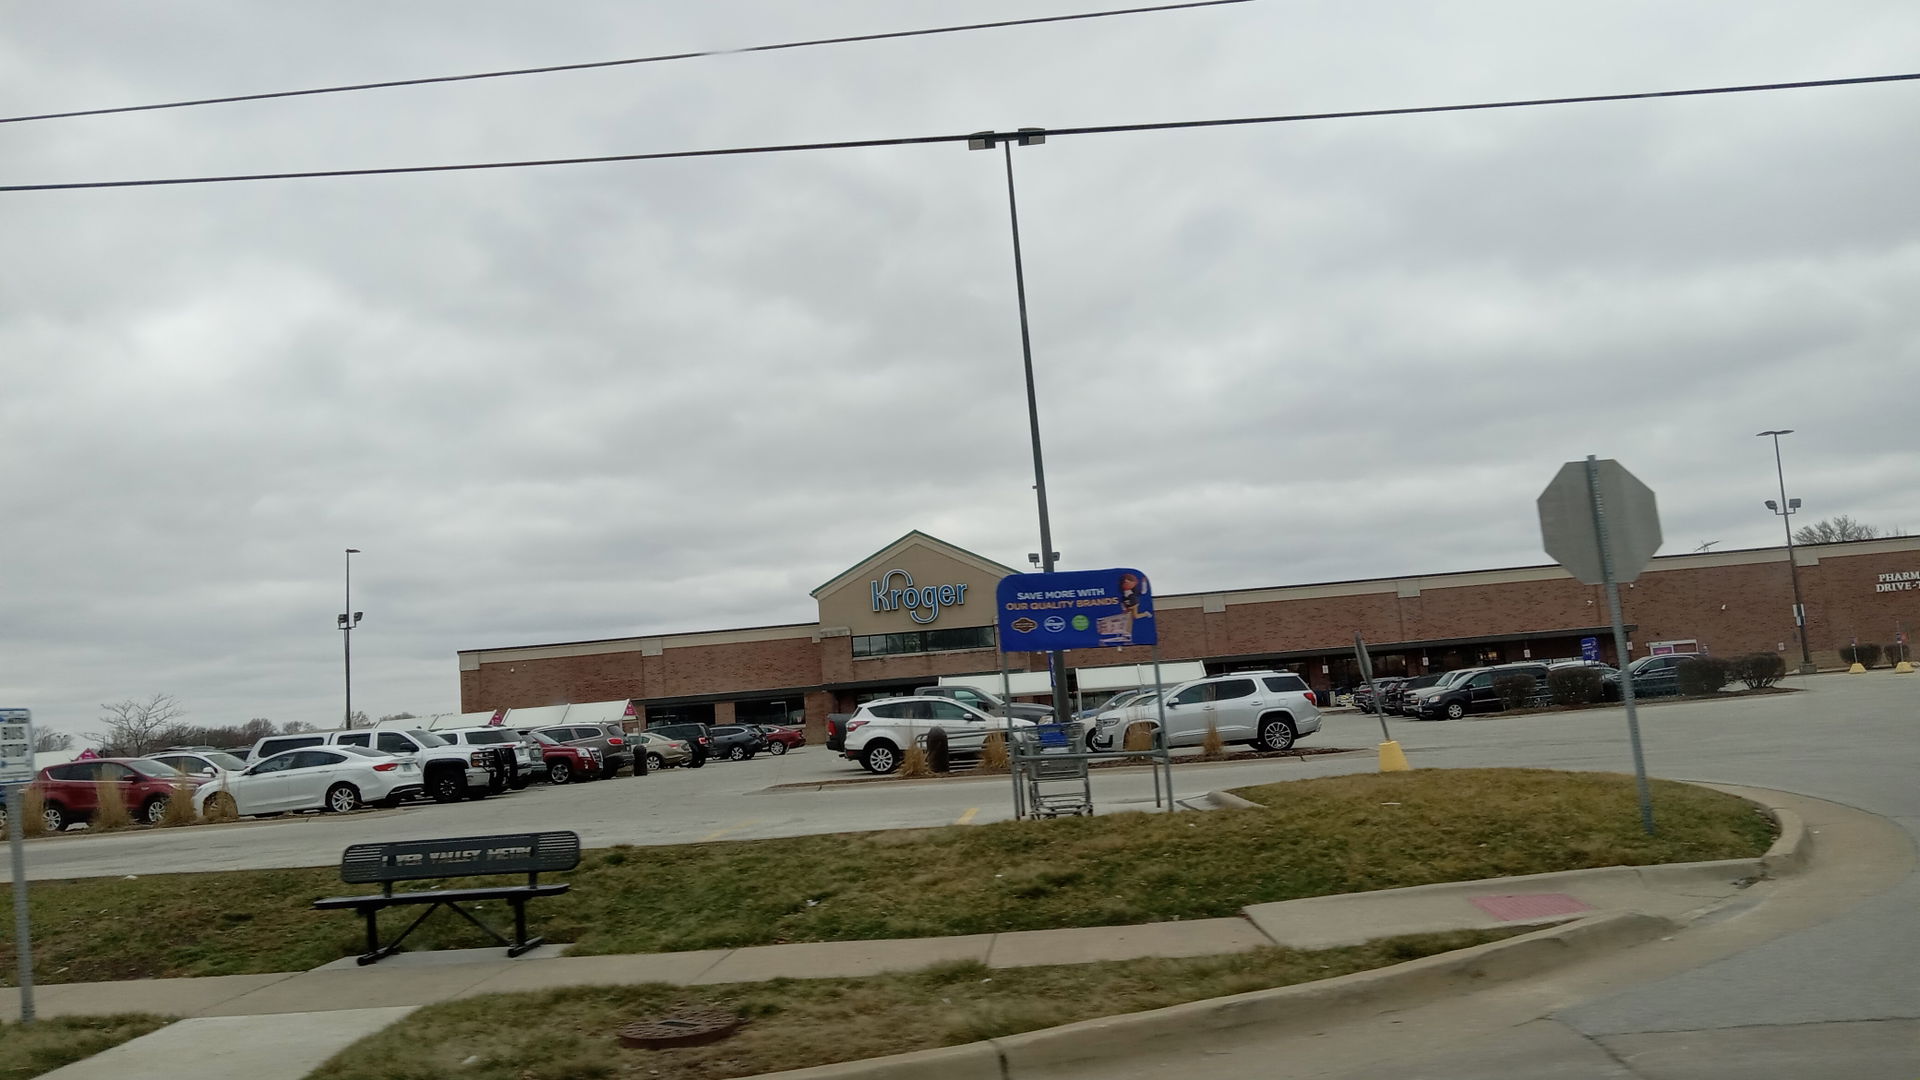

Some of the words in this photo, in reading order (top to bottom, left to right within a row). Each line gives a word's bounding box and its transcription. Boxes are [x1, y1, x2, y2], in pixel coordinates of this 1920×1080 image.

[871, 568, 968, 624] Kroger
[1016, 592, 1044, 600] SAVE
[1045, 590, 1076, 599] MORE
[1077, 588, 1105, 597] WITH
[1006, 602, 1029, 611] OUR
[1030, 600, 1074, 610] QUALITY
[1076, 597, 1120, 608] BRANDS
